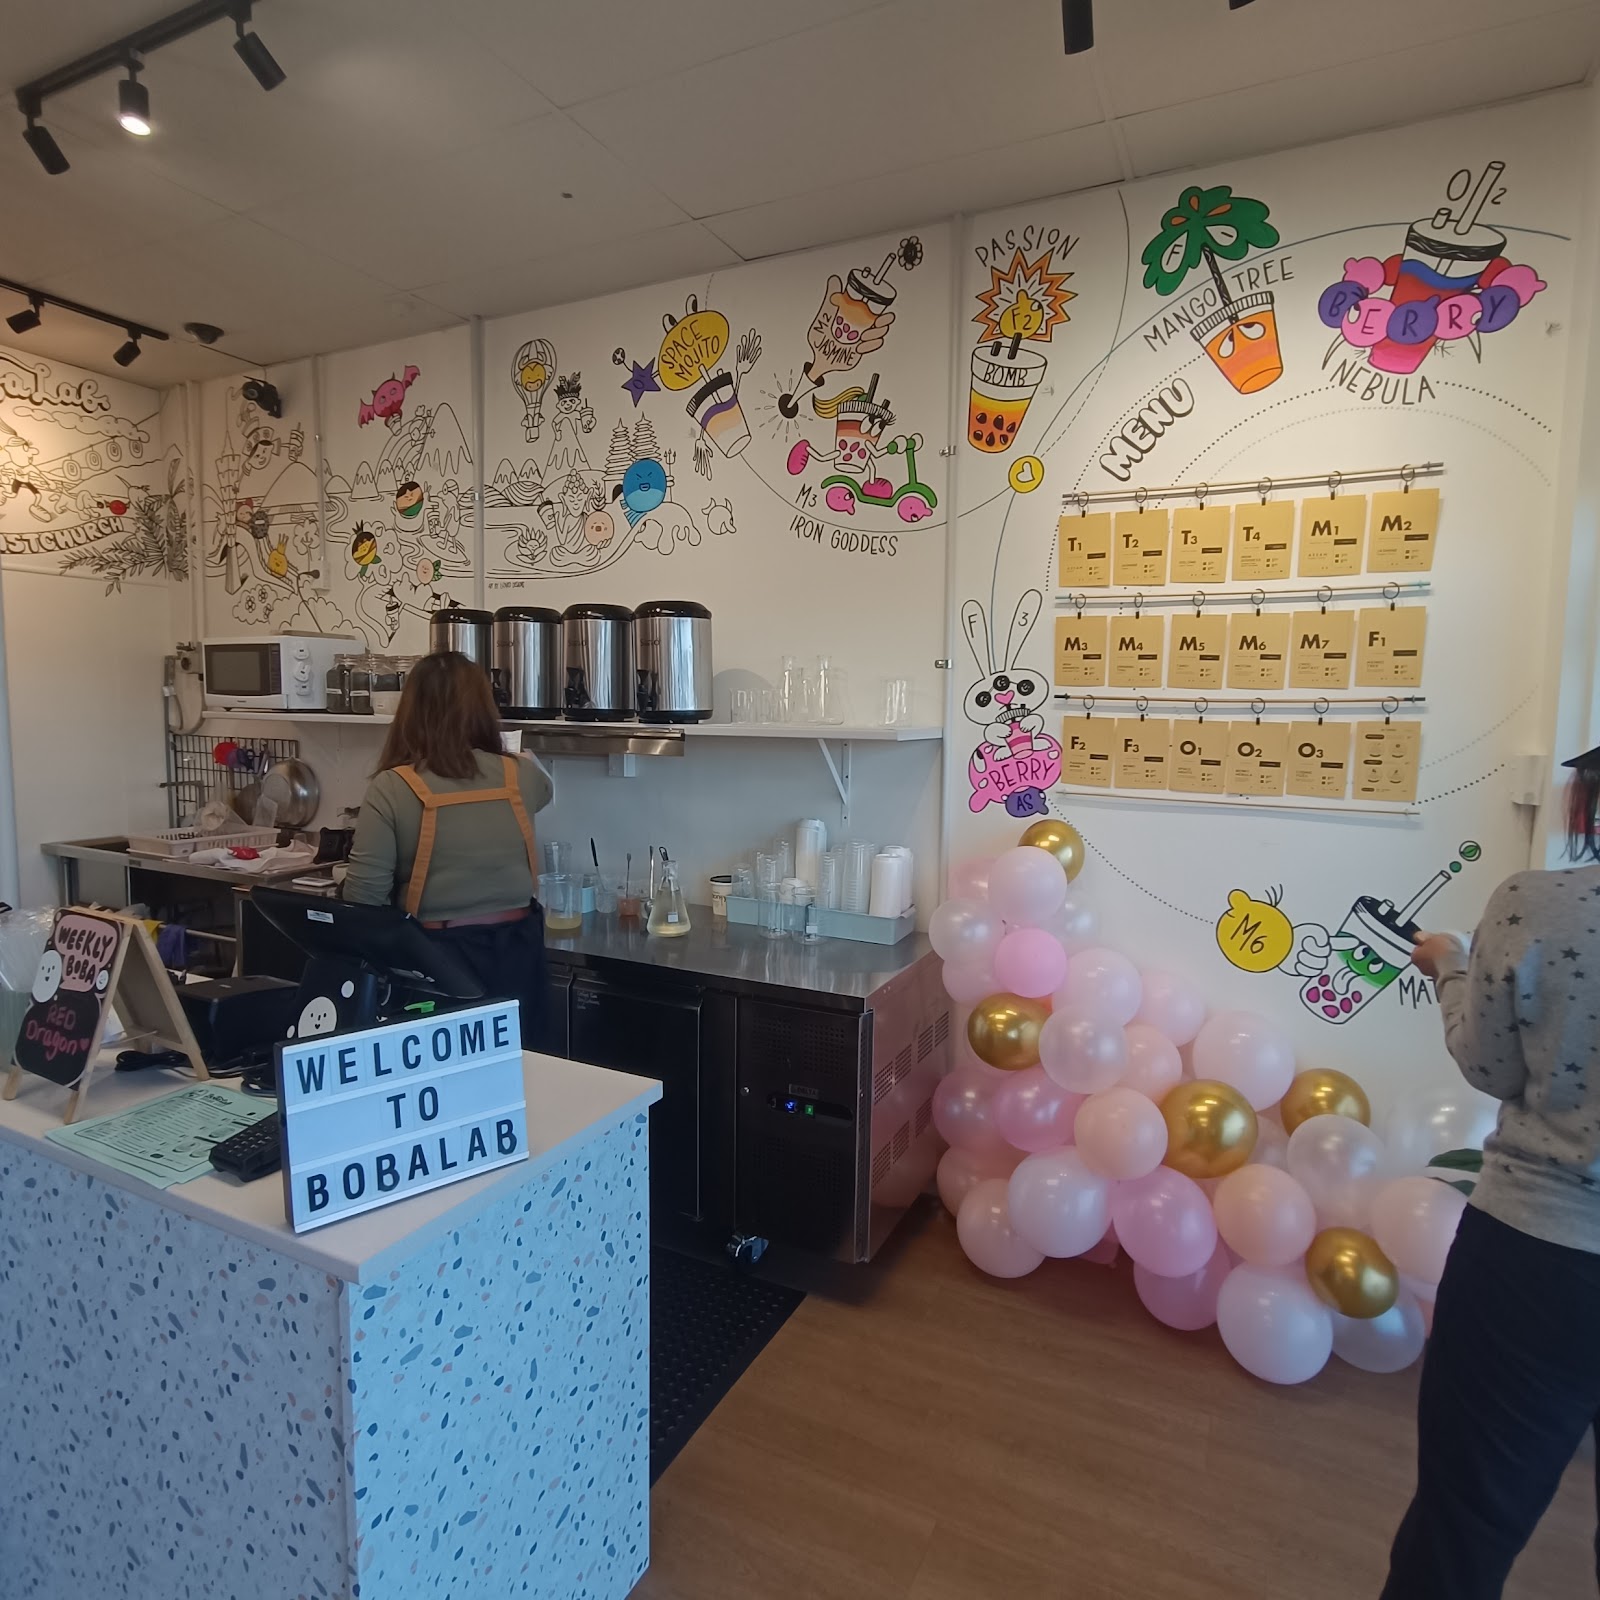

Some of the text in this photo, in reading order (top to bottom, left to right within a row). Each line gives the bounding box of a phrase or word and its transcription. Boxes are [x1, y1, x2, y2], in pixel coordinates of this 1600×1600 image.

[975, 225, 1080, 267] PASSION
[1143, 256, 1295, 352] MANGO TREE
[1329, 291, 1505, 338] BERRY
[813, 312, 833, 334] M2
[1011, 306, 1032, 331] F2
[661, 319, 702, 370] SPACE
[813, 335, 856, 366] JASMINE
[674, 335, 720, 382] MOJITO
[984, 362, 1028, 386] BOMB
[1329, 358, 1436, 405] NEBULA
[1099, 378, 1195, 482] MENU
[795, 483, 818, 508] M3
[1242, 526, 1260, 541] T4
[1311, 520, 1339, 536] M1
[1380, 515, 1412, 531] M2
[789, 515, 898, 556] IRON GODDESS
[1068, 537, 1082, 551] T1
[1122, 534, 1139, 548] T2
[1181, 530, 1198, 545] T3
[1064, 637, 1088, 651] M3
[1118, 637, 1143, 651] M4
[1179, 636, 1205, 651] M5
[1239, 635, 1266, 651] M6
[1300, 634, 1330, 649] M7
[1368, 631, 1386, 647] F1
[1071, 736, 1086, 750] F2
[1124, 738, 1140, 753] F3
[1180, 741, 1202, 756] O1
[1237, 742, 1262, 758] O2
[1298, 742, 1324, 758] O3
[989, 758, 1055, 791] BERRY
[1016, 793, 1033, 812] AS
[58, 925, 114, 963] WEEKLY
[1230, 913, 1268, 954] M6
[66, 955, 96, 985] BOBA
[1398, 975, 1441, 1010] MAT
[47, 1004, 77, 1030] RED
[296, 1014, 509, 1094] WELCOME
[386, 1086, 439, 1129] TO
[307, 1119, 518, 1212] BOBALAB
